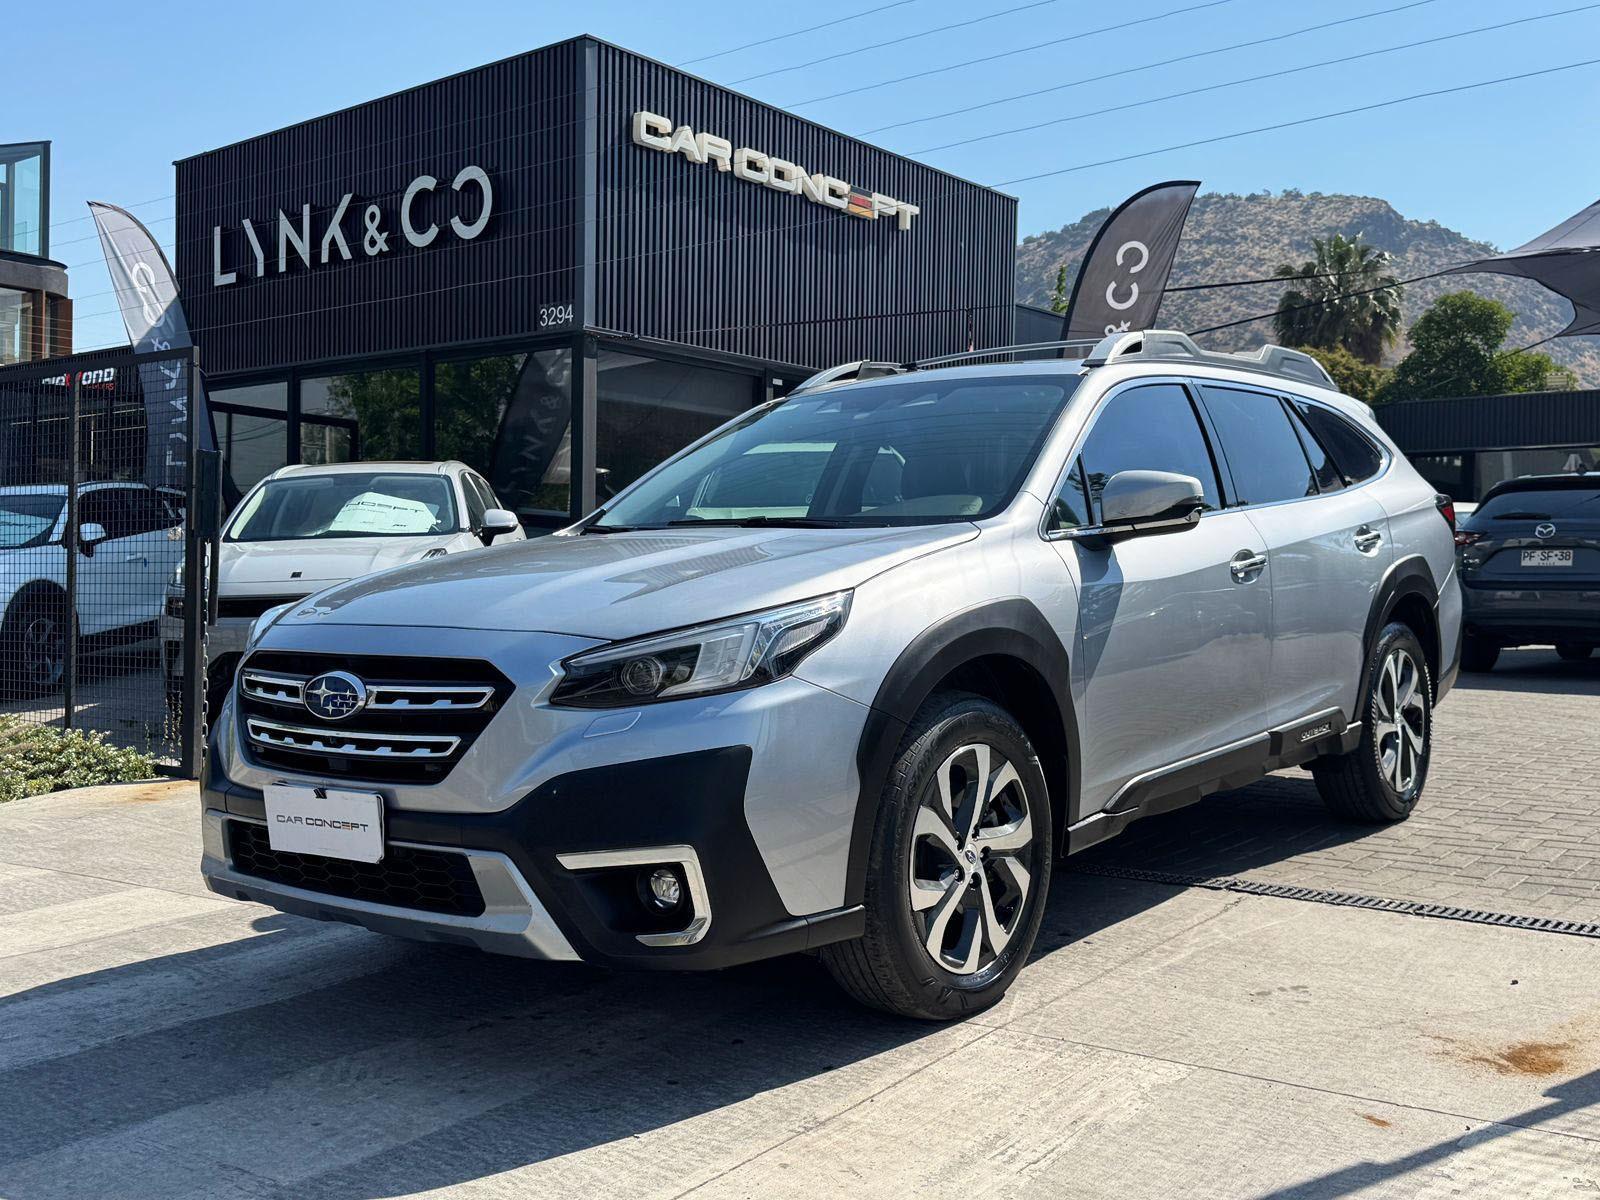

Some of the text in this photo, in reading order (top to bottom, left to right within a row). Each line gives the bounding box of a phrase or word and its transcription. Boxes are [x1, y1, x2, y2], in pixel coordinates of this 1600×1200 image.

[633, 111, 920, 231] CAR CONCEPT
[213, 193, 353, 287] LYNK
[364, 204, 390, 256] &
[540, 304, 573, 327] 3294
[276, 814, 369, 833] CAR CONCEPT
